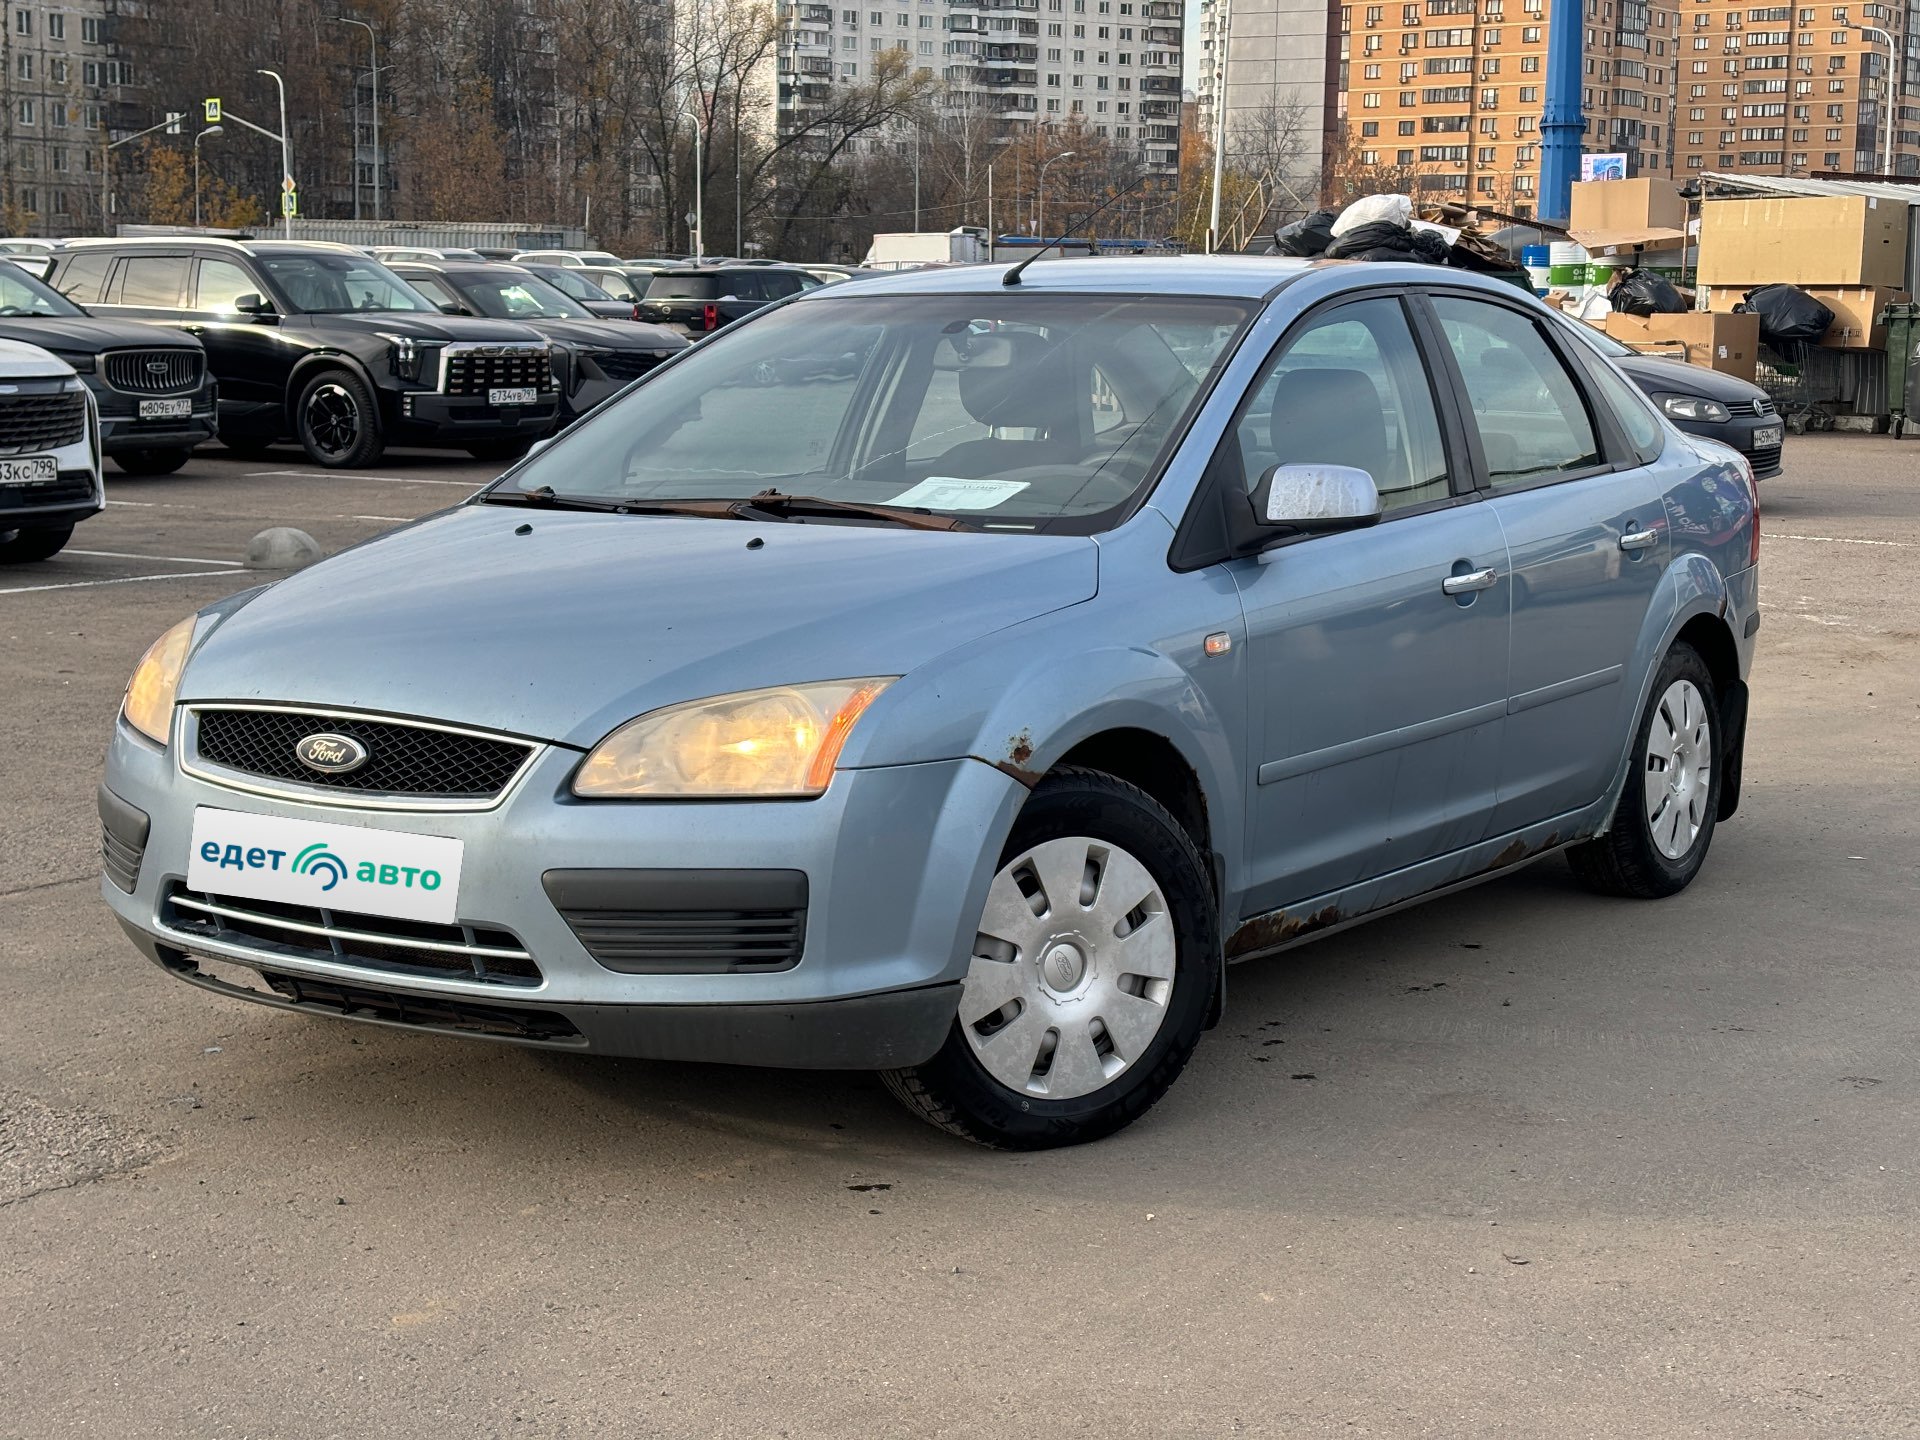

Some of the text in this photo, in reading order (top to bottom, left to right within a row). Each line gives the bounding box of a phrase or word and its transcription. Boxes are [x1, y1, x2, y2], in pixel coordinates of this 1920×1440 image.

[141, 402, 176, 415] М809ЕУ
[33, 460, 53, 474] 799
[308, 740, 347, 764] Ford
